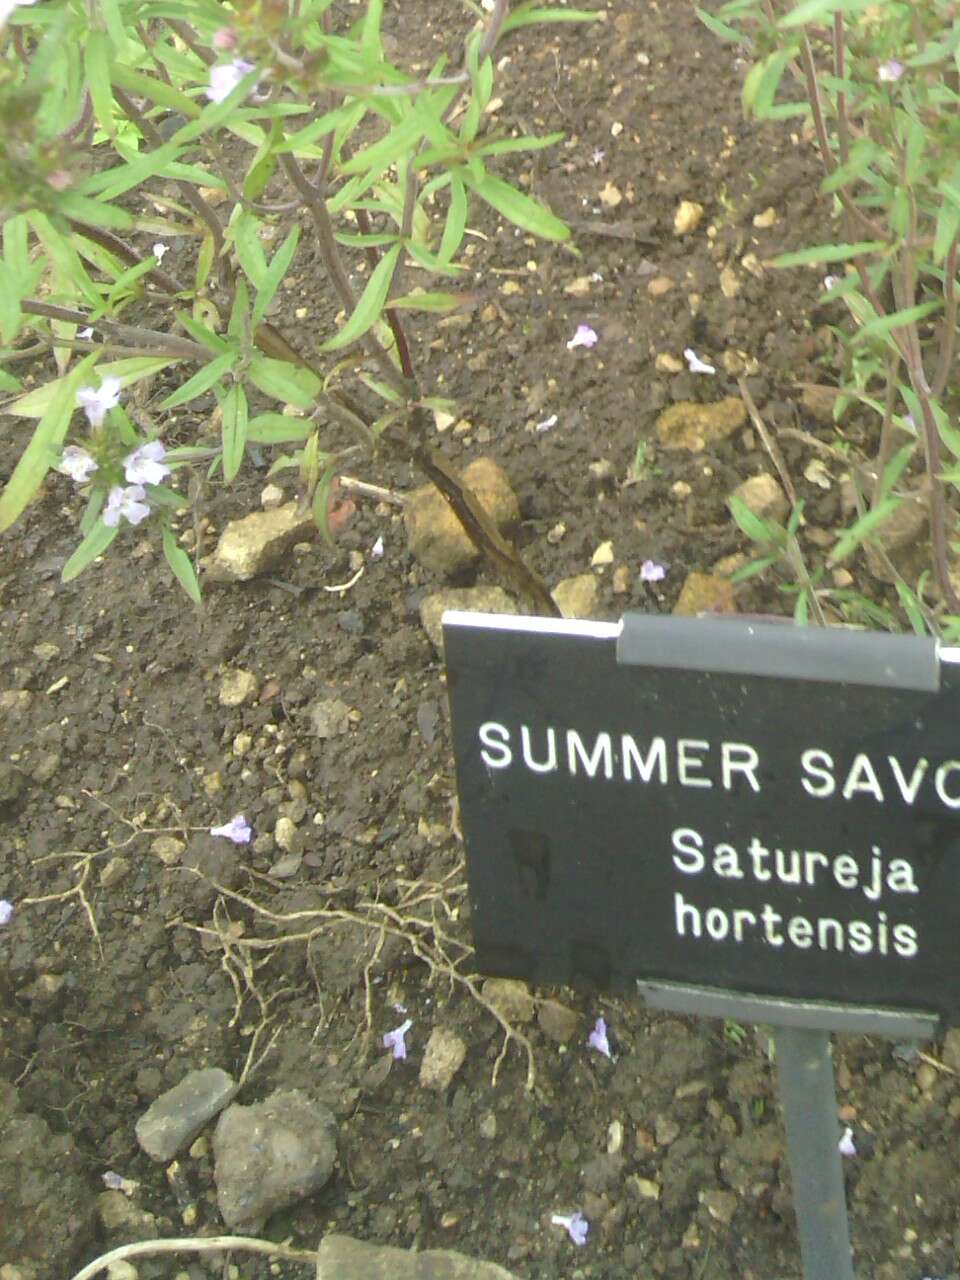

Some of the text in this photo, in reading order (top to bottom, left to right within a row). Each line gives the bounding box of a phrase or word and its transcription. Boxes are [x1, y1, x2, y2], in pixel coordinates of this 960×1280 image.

[478, 721, 762, 793] SUMMER
[671, 827, 919, 901] Satureja
[674, 892, 919, 958] hortensis
